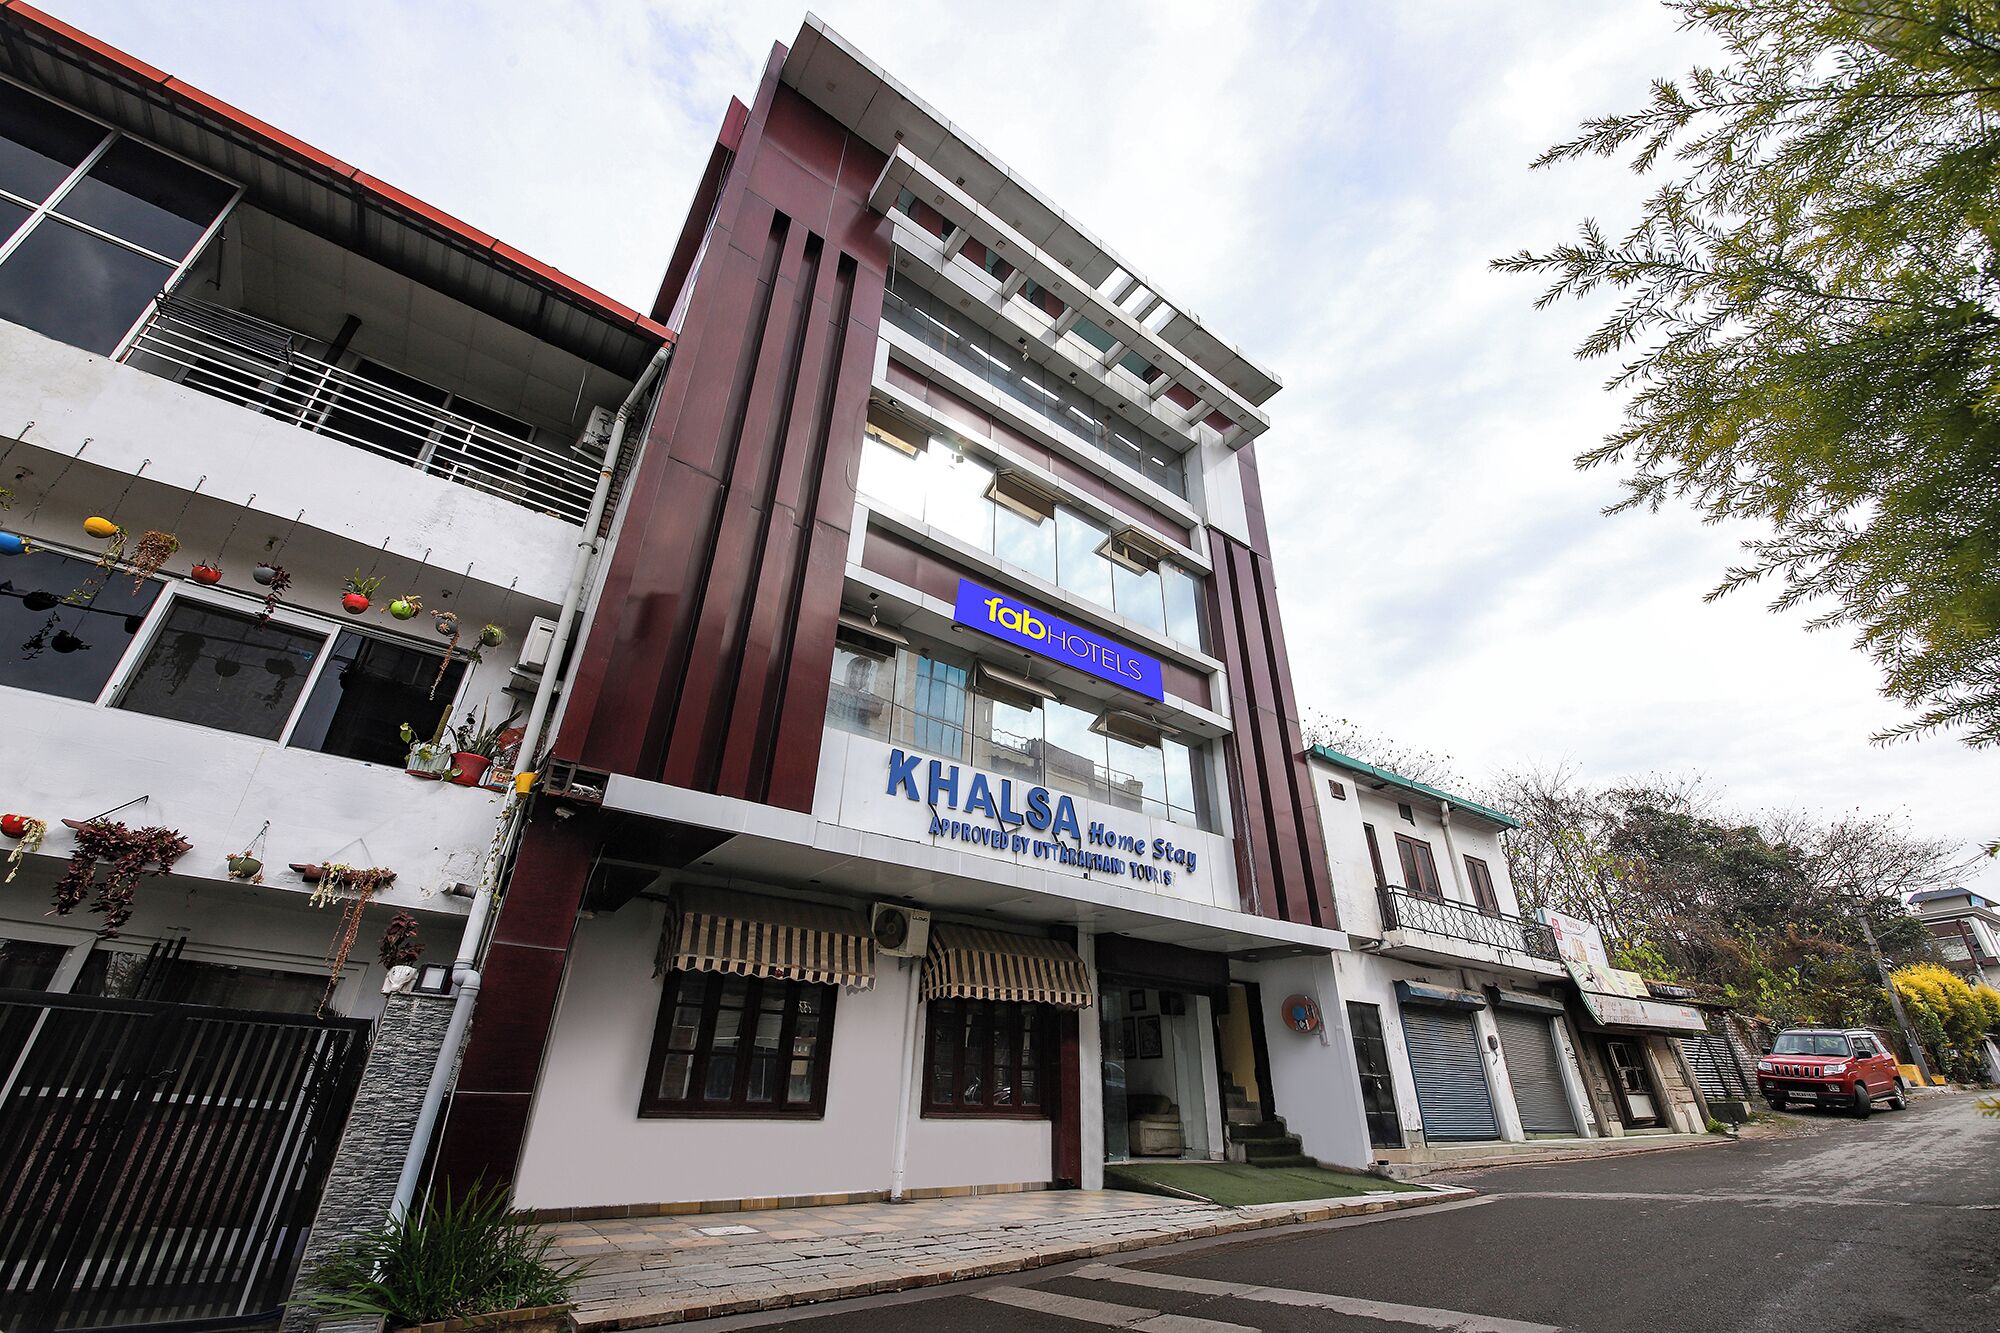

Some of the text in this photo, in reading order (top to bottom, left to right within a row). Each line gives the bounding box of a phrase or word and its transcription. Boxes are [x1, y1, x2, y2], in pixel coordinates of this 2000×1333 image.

[886, 748, 1198, 873] KHALSA Home Stay
[928, 815, 1177, 887] APPROVED BY UTTARAKHAND TOURIS
